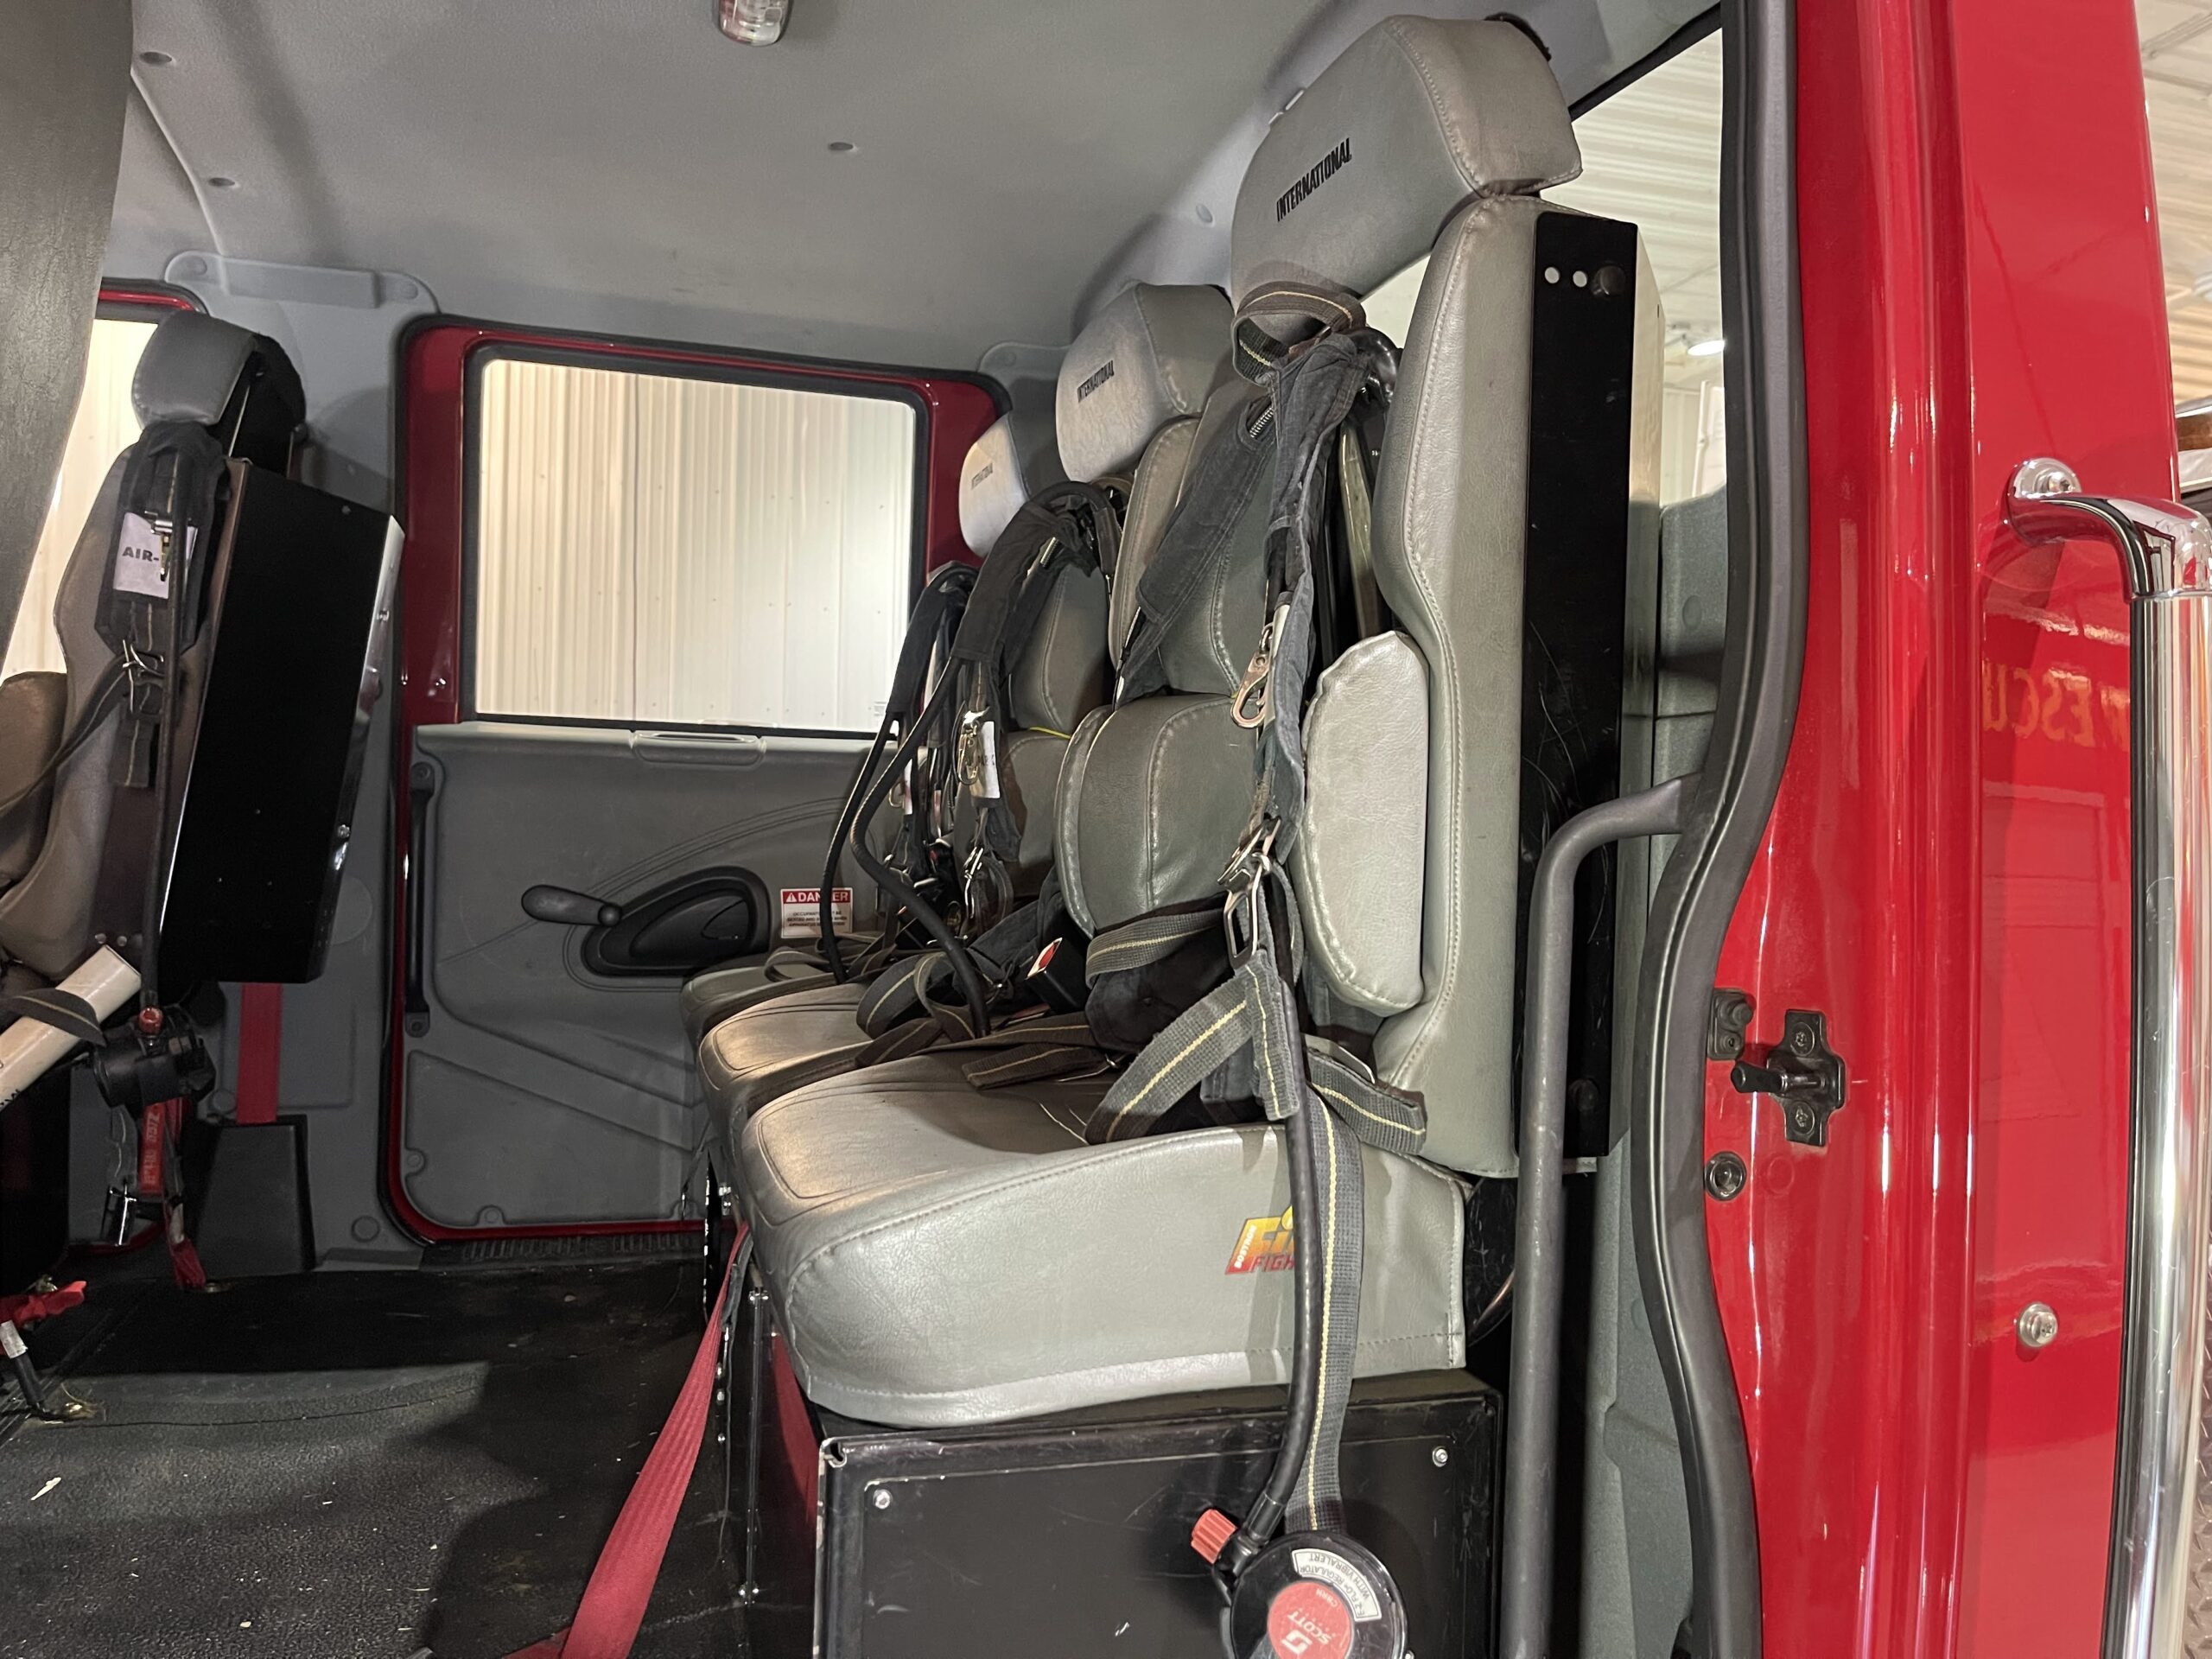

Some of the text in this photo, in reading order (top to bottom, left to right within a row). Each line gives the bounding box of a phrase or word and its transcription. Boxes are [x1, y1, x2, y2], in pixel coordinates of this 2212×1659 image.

[1276, 137, 1351, 222] INTERNATIONAL
[122, 546, 160, 562] AIR-
[798, 892, 849, 902] DANER
[1300, 1565, 1344, 1585] REGULATOR
[1309, 1553, 1370, 1599] WITH VIBRALERT
[1287, 1611, 1332, 1645] SCOTT
